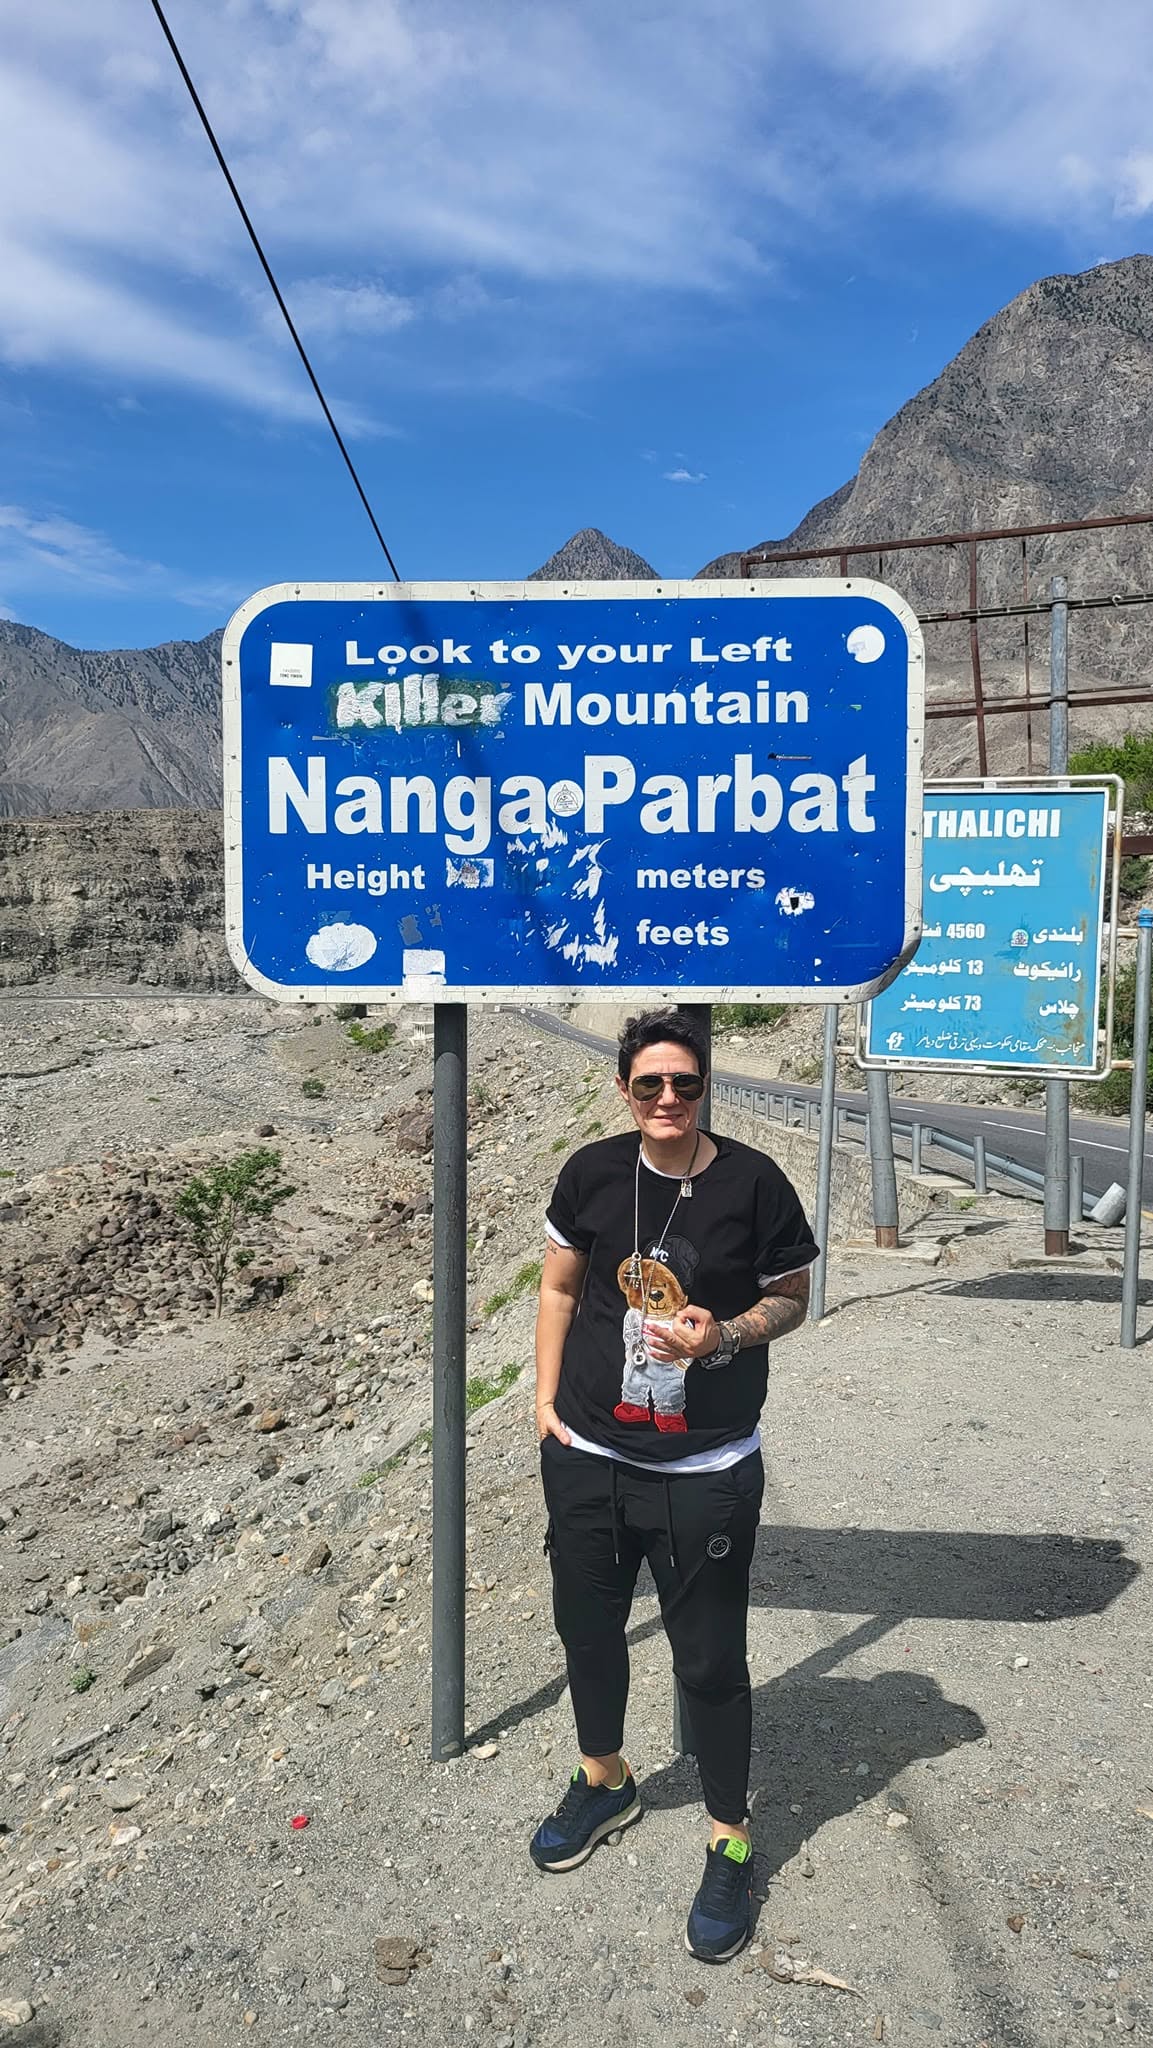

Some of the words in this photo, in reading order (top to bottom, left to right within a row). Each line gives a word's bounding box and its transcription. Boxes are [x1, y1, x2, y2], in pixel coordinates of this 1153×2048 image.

[346, 639, 473, 665] Look
[489, 639, 541, 664] to
[557, 642, 673, 670] your
[690, 637, 793, 663] Left
[336, 673, 515, 731] Killer
[524, 681, 809, 726] Mountain
[267, 756, 547, 856] Nanga
[584, 754, 876, 834] Parbat
[922, 809, 1061, 838] THALICHI
[306, 862, 426, 896] Height
[636, 863, 766, 889] meters
[636, 919, 730, 946] feets
[946, 923, 985, 939] 4560
[1032, 926, 1083, 946] بلندی
[966, 959, 984, 975] 13
[964, 995, 981, 1011] 73
[1039, 999, 1080, 1020] چلاس
